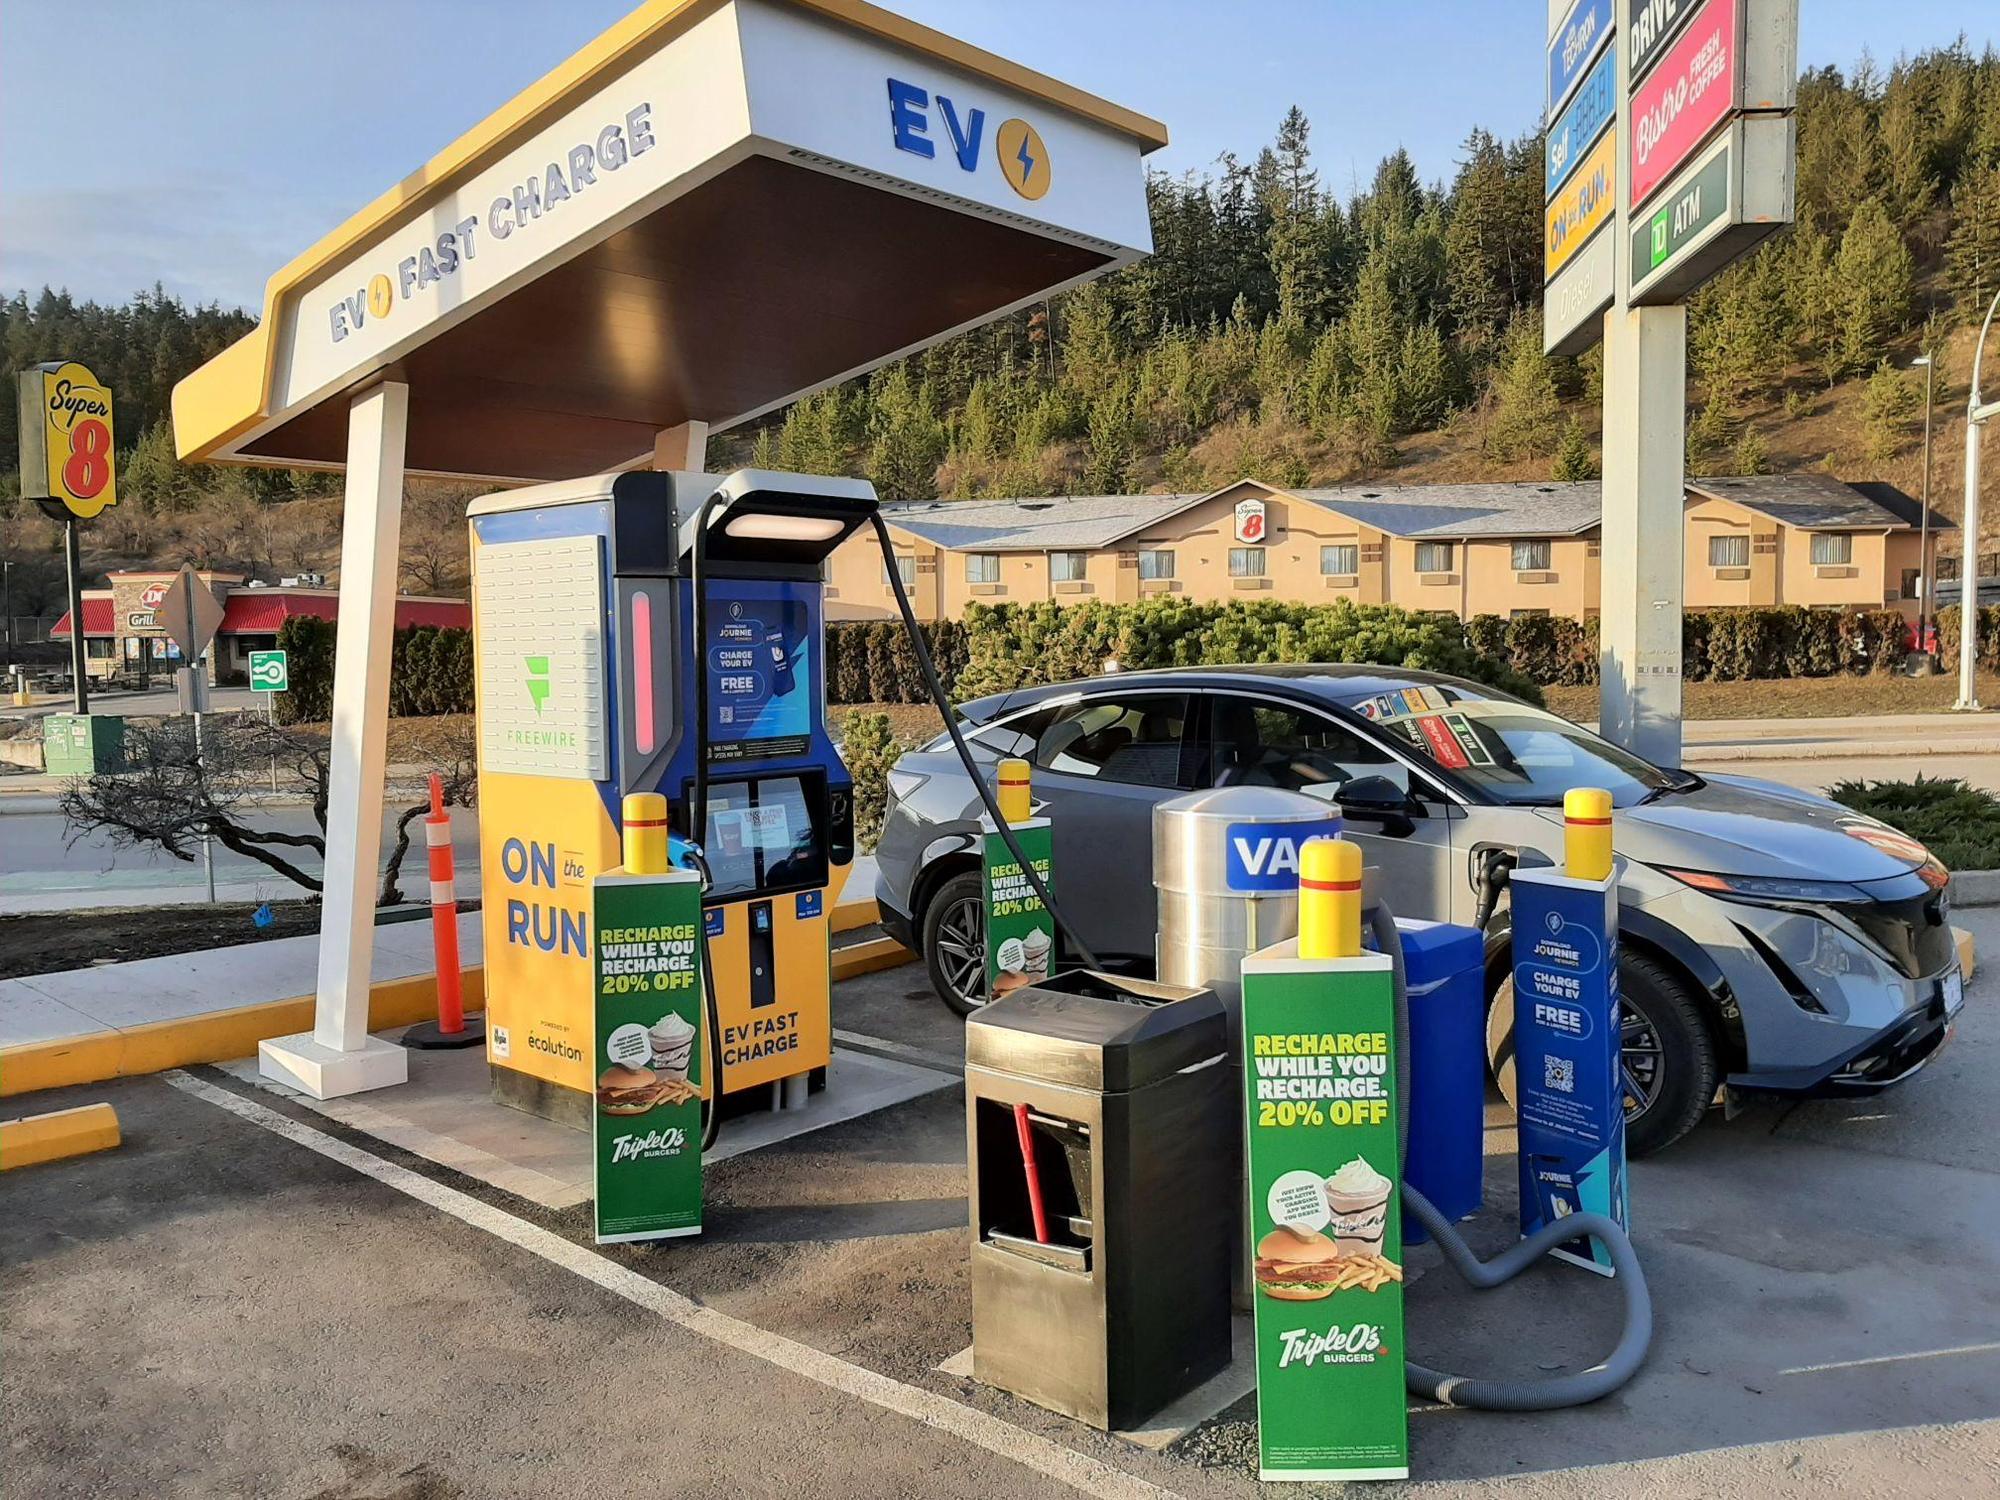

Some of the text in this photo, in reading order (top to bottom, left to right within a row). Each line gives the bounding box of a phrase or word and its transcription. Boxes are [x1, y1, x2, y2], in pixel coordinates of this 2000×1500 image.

[1689, 27, 1720, 81] FRESH
[1689, 47, 1727, 105] COFFEE
[1637, 75, 1688, 166] Bistro
[1551, 126, 1569, 176] Self
[399, 215, 478, 300] FAST
[488, 102, 656, 240] CHARGE
[1551, 208, 1567, 253] ON
[1578, 163, 1606, 225] RUN
[1652, 186, 1701, 253] TD ATM
[1560, 259, 1595, 321] Diesel
[50, 379, 108, 427] Super
[62, 418, 111, 499] 8
[1242, 514, 1263, 538] 8
[131, 615, 154, 626] Grill
[720, 629, 753, 638] JOURNIE
[719, 650, 753, 660] CHARGE
[720, 660, 741, 668] YOUR
[720, 677, 754, 690] FREE
[507, 730, 577, 747] FREEWIRE
[502, 837, 585, 889] ON the
[990, 859, 1049, 878] RECHGE
[991, 874, 1027, 889] WHILE
[993, 896, 1046, 917] 20% OF
[508, 898, 587, 958] RUN
[600, 924, 695, 944] RECHARGE
[601, 940, 695, 959] WHILE YOU
[1533, 944, 1580, 961] JOURNIE
[601, 955, 695, 975] RECHARGE.
[602, 970, 695, 994] 20% OFF
[1533, 971, 1580, 990] CHARGE
[1534, 982, 1580, 1000] YOUR EV
[1535, 1003, 1581, 1028] FREE
[724, 1011, 799, 1045] EV FAST
[723, 1033, 799, 1066] CHARGE
[1253, 1033, 1387, 1056] RECHARGE
[1254, 1055, 1387, 1077] WHILE YOU
[1256, 1077, 1388, 1099] RECHARGE.
[1258, 1099, 1388, 1127] 20% OFF
[644, 1148, 680, 1158] BURGERS
[1323, 1353, 1375, 1363] BURGERS
